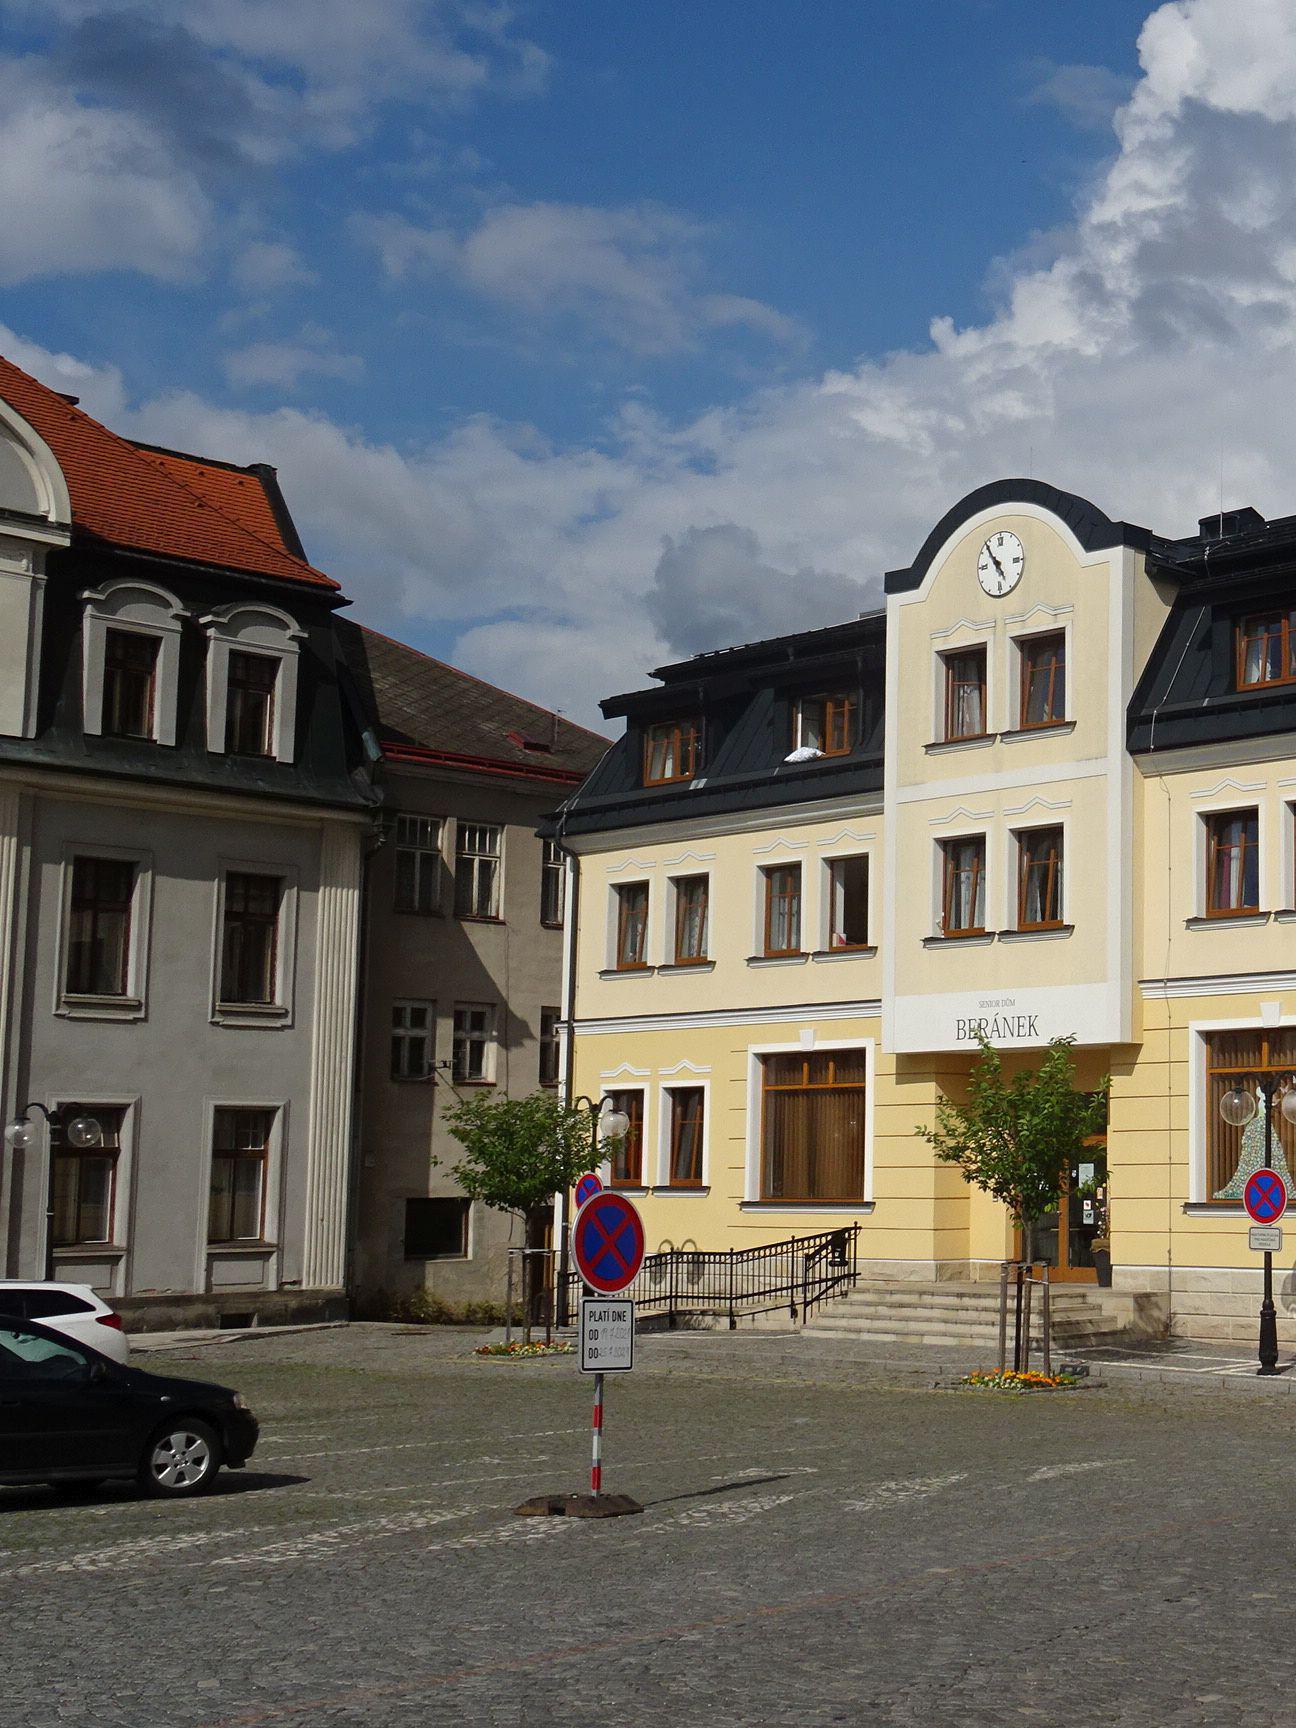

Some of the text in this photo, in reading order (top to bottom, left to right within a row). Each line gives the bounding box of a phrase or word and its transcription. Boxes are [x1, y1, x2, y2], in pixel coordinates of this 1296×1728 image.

[956, 1012, 1039, 1041] BERÁNEK
[589, 1308, 627, 1322] PLATÍ DNE
[588, 1329, 599, 1340] OD
[588, 1347, 599, 1359] DO
